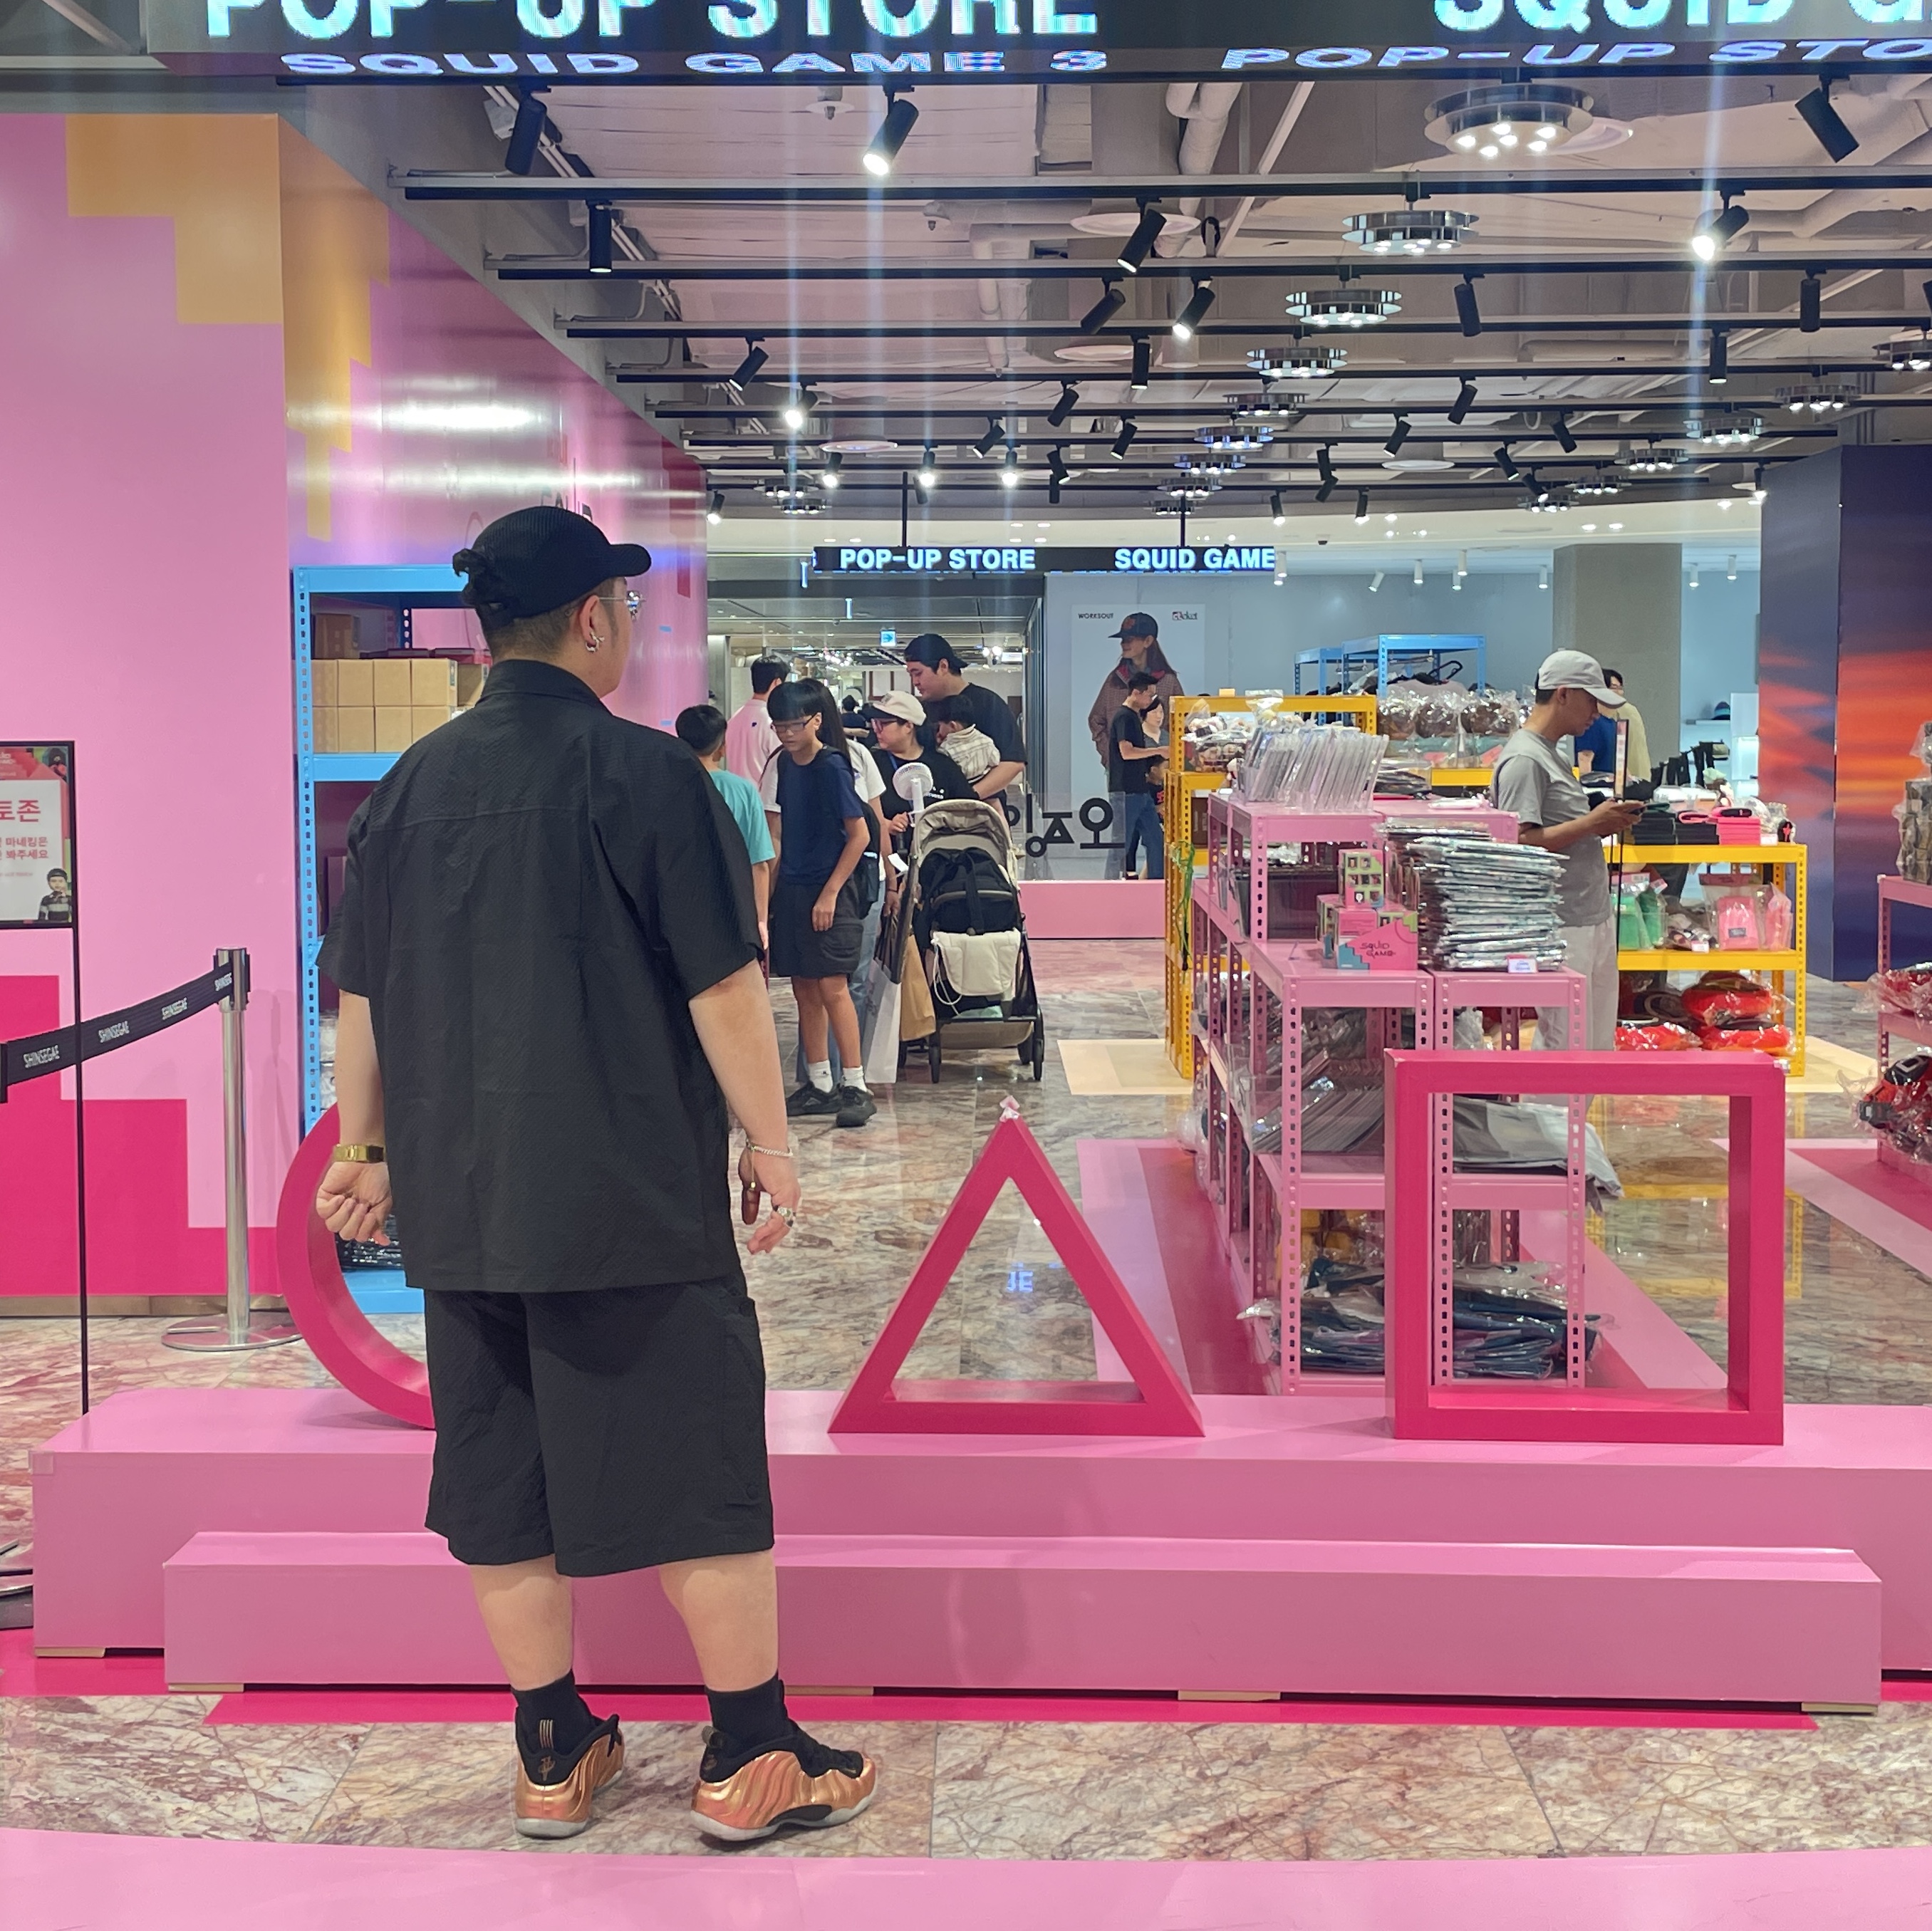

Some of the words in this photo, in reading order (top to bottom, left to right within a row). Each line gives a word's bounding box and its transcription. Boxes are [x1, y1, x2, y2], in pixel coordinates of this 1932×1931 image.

[281, 53, 639, 75] SQUID
[685, 51, 1005, 73] GAME
[1050, 50, 1107, 71] 3
[1221, 43, 1675, 70] POP-UP
[840, 548, 942, 569] POP-UP
[949, 548, 1036, 569] STORE
[1115, 548, 1196, 569] SQUID
[1204, 548, 1275, 568] GAME
